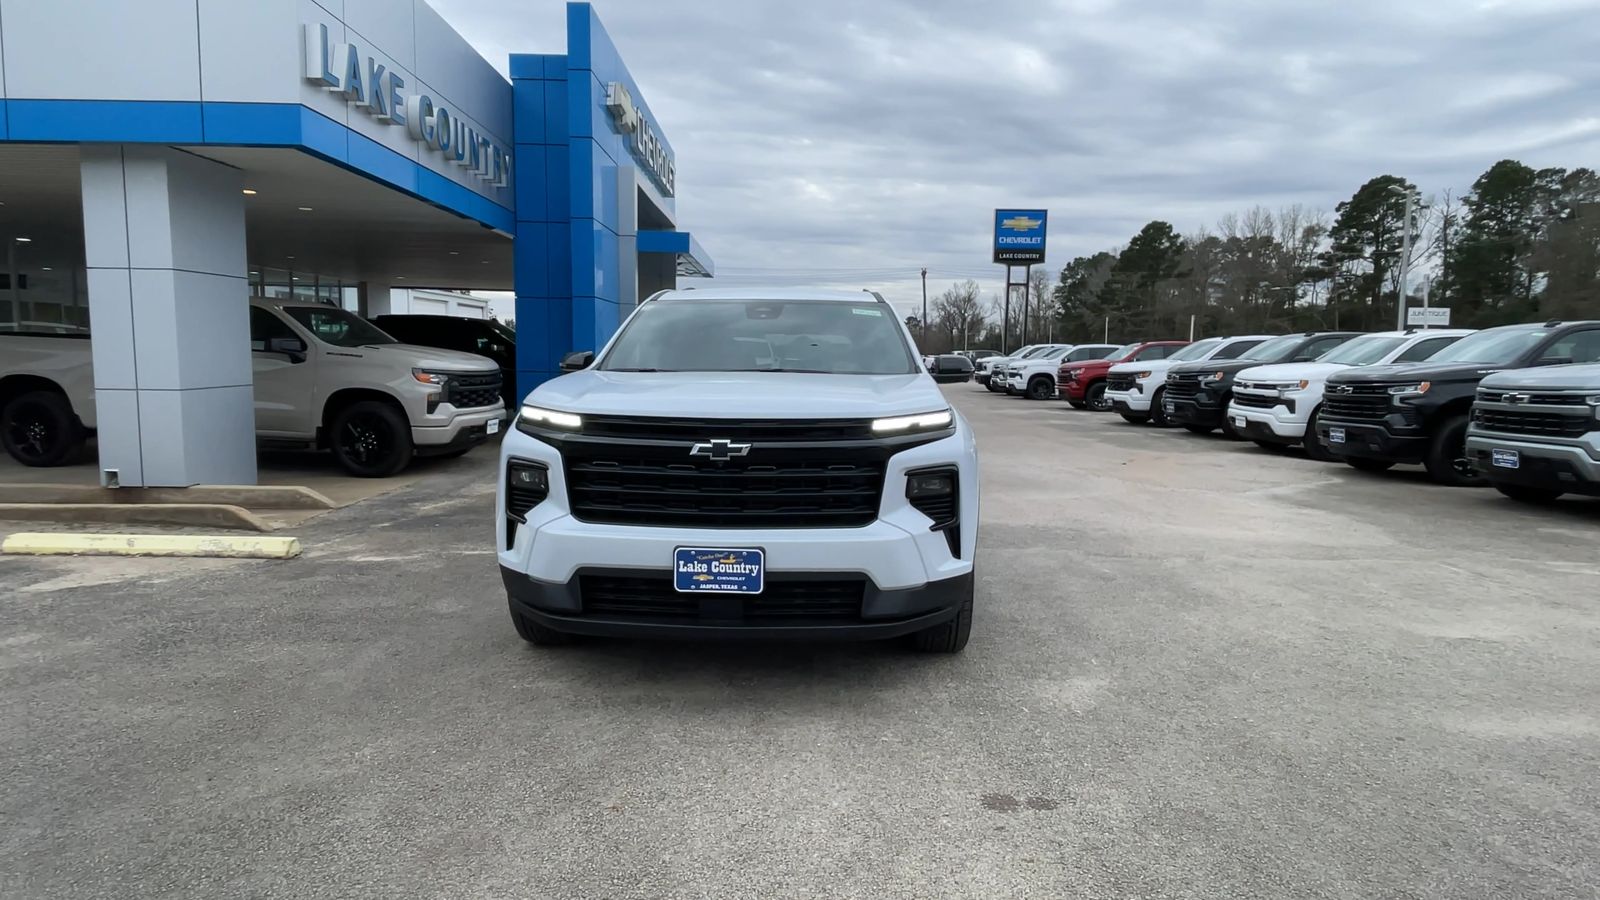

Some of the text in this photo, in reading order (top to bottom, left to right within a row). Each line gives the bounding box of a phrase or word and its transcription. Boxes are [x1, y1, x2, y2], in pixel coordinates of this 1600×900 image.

[304, 23, 512, 187] LAKE COUNTRY
[999, 236, 1042, 244] CHEVROLET
[678, 560, 759, 577] Lake Country
